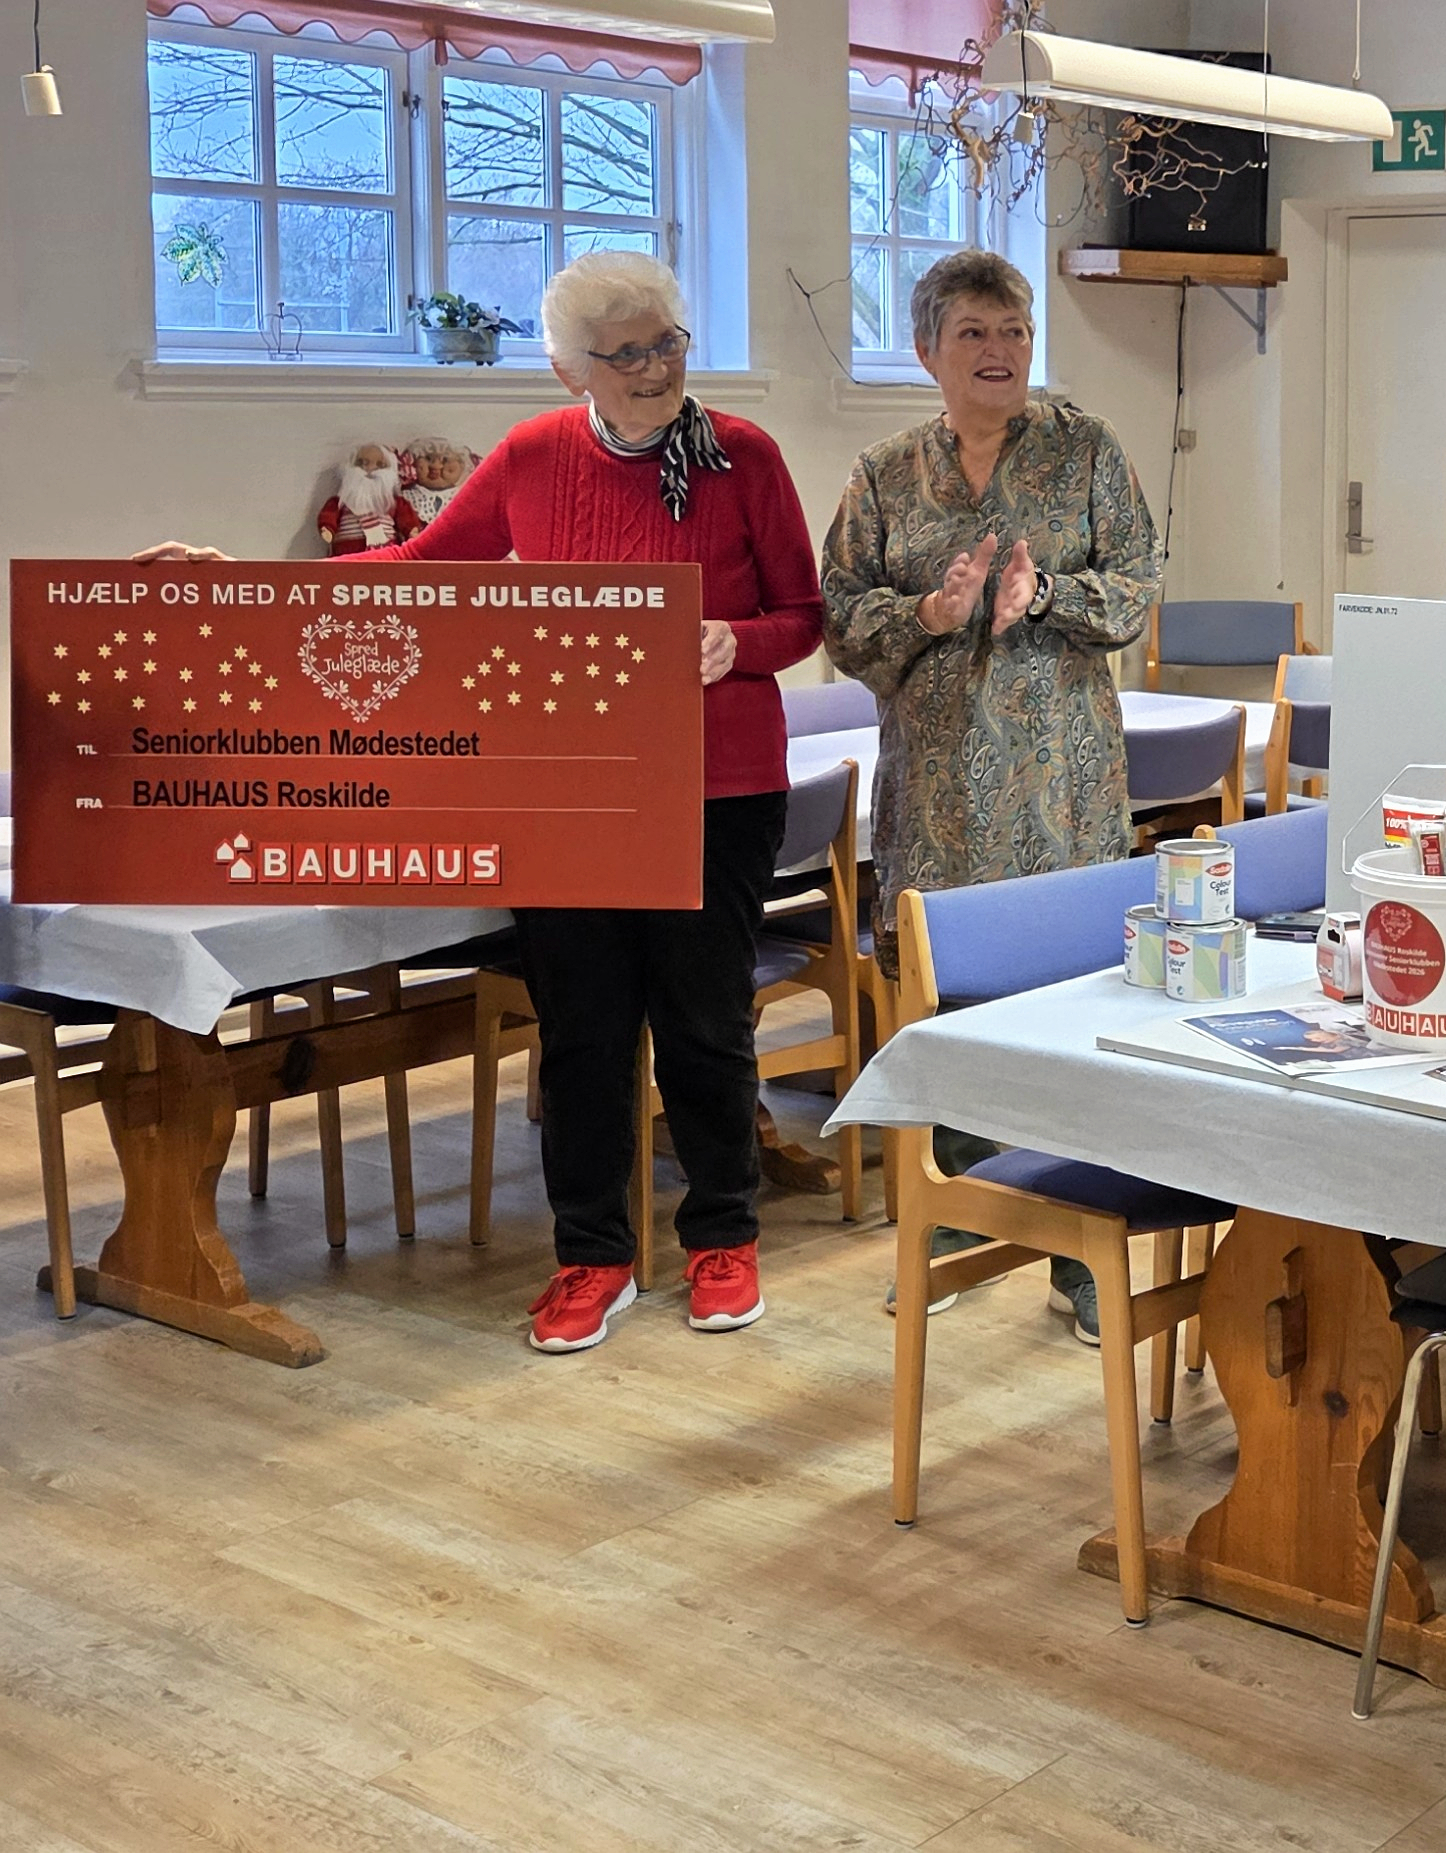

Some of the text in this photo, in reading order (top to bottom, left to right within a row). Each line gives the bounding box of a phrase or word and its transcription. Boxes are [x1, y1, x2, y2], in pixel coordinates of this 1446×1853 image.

[48, 582, 665, 608] HJÆLP OS MED AT SPREDE JULEGLÆDE
[344, 641, 378, 659] Spred
[321, 653, 400, 679] Juleglæde
[76, 726, 481, 757] TIL Seniorklubben Mødestedet
[76, 780, 391, 810] FRA BAUHAUS Roskilde
[263, 846, 498, 880] BAUHAUS
